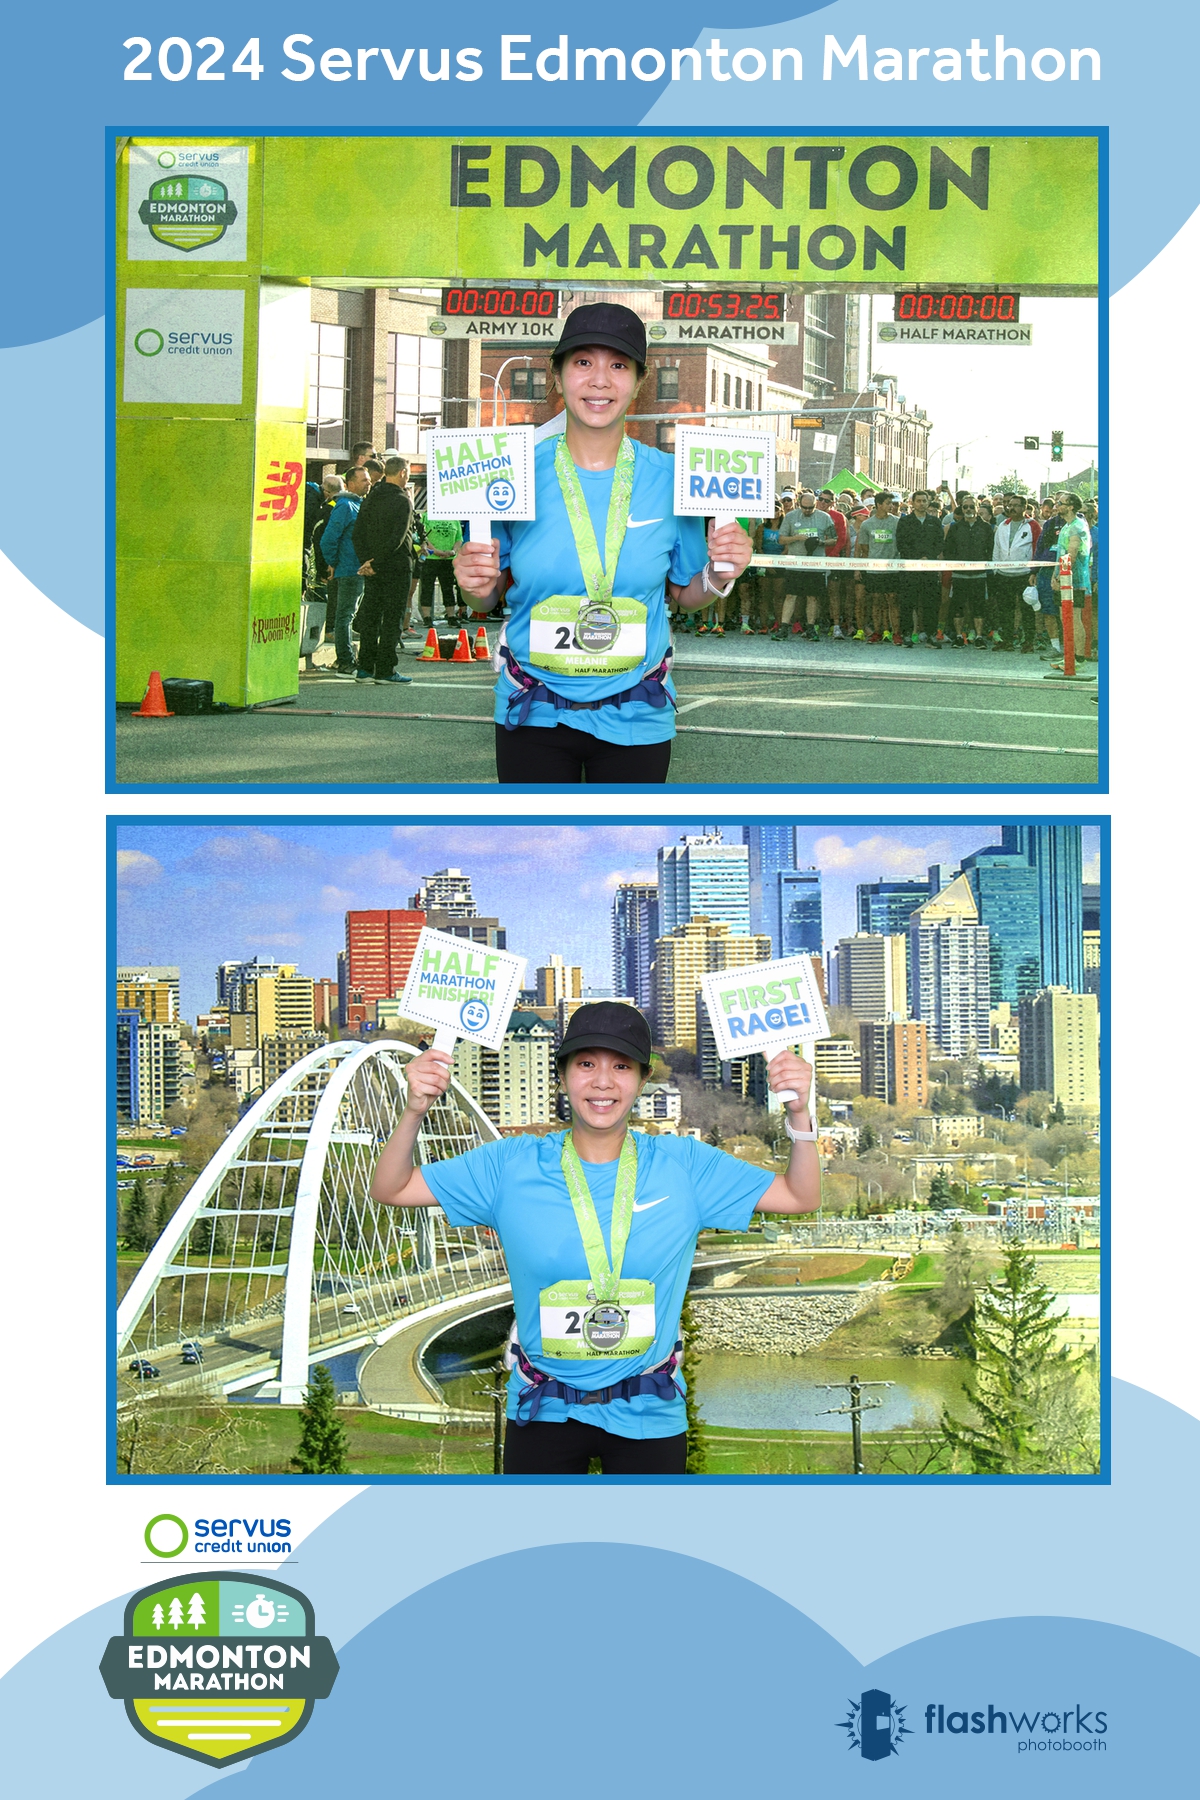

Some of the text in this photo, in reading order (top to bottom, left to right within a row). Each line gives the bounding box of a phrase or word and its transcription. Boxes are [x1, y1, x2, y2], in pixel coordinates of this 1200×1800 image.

[178, 151, 219, 161] servus
[178, 160, 199, 168] credit
[450, 145, 990, 211] EDMONTON
[149, 202, 227, 213] EDMONTON
[160, 214, 215, 222] MARATHON
[523, 224, 906, 272] MARATHON
[168, 331, 233, 345] servus
[465, 321, 554, 336] ARMY 10K
[678, 324, 785, 340] MARATHON
[900, 328, 1031, 341] HALF MARATHON
[167, 345, 233, 356] credit union
[435, 432, 508, 471] HALF
[689, 446, 765, 475] FIRST
[438, 454, 512, 483] MARATHON
[440, 467, 515, 497] FINISHER!
[689, 475, 763, 500] RACE!
[257, 613, 291, 642] Running
[565, 656, 608, 666] MELANIE
[422, 949, 500, 977] HALF
[420, 971, 496, 991] MARATHON
[418, 984, 495, 1006] FINISHER!
[719, 976, 803, 1015] FIRST
[726, 1002, 812, 1039] RACE!
